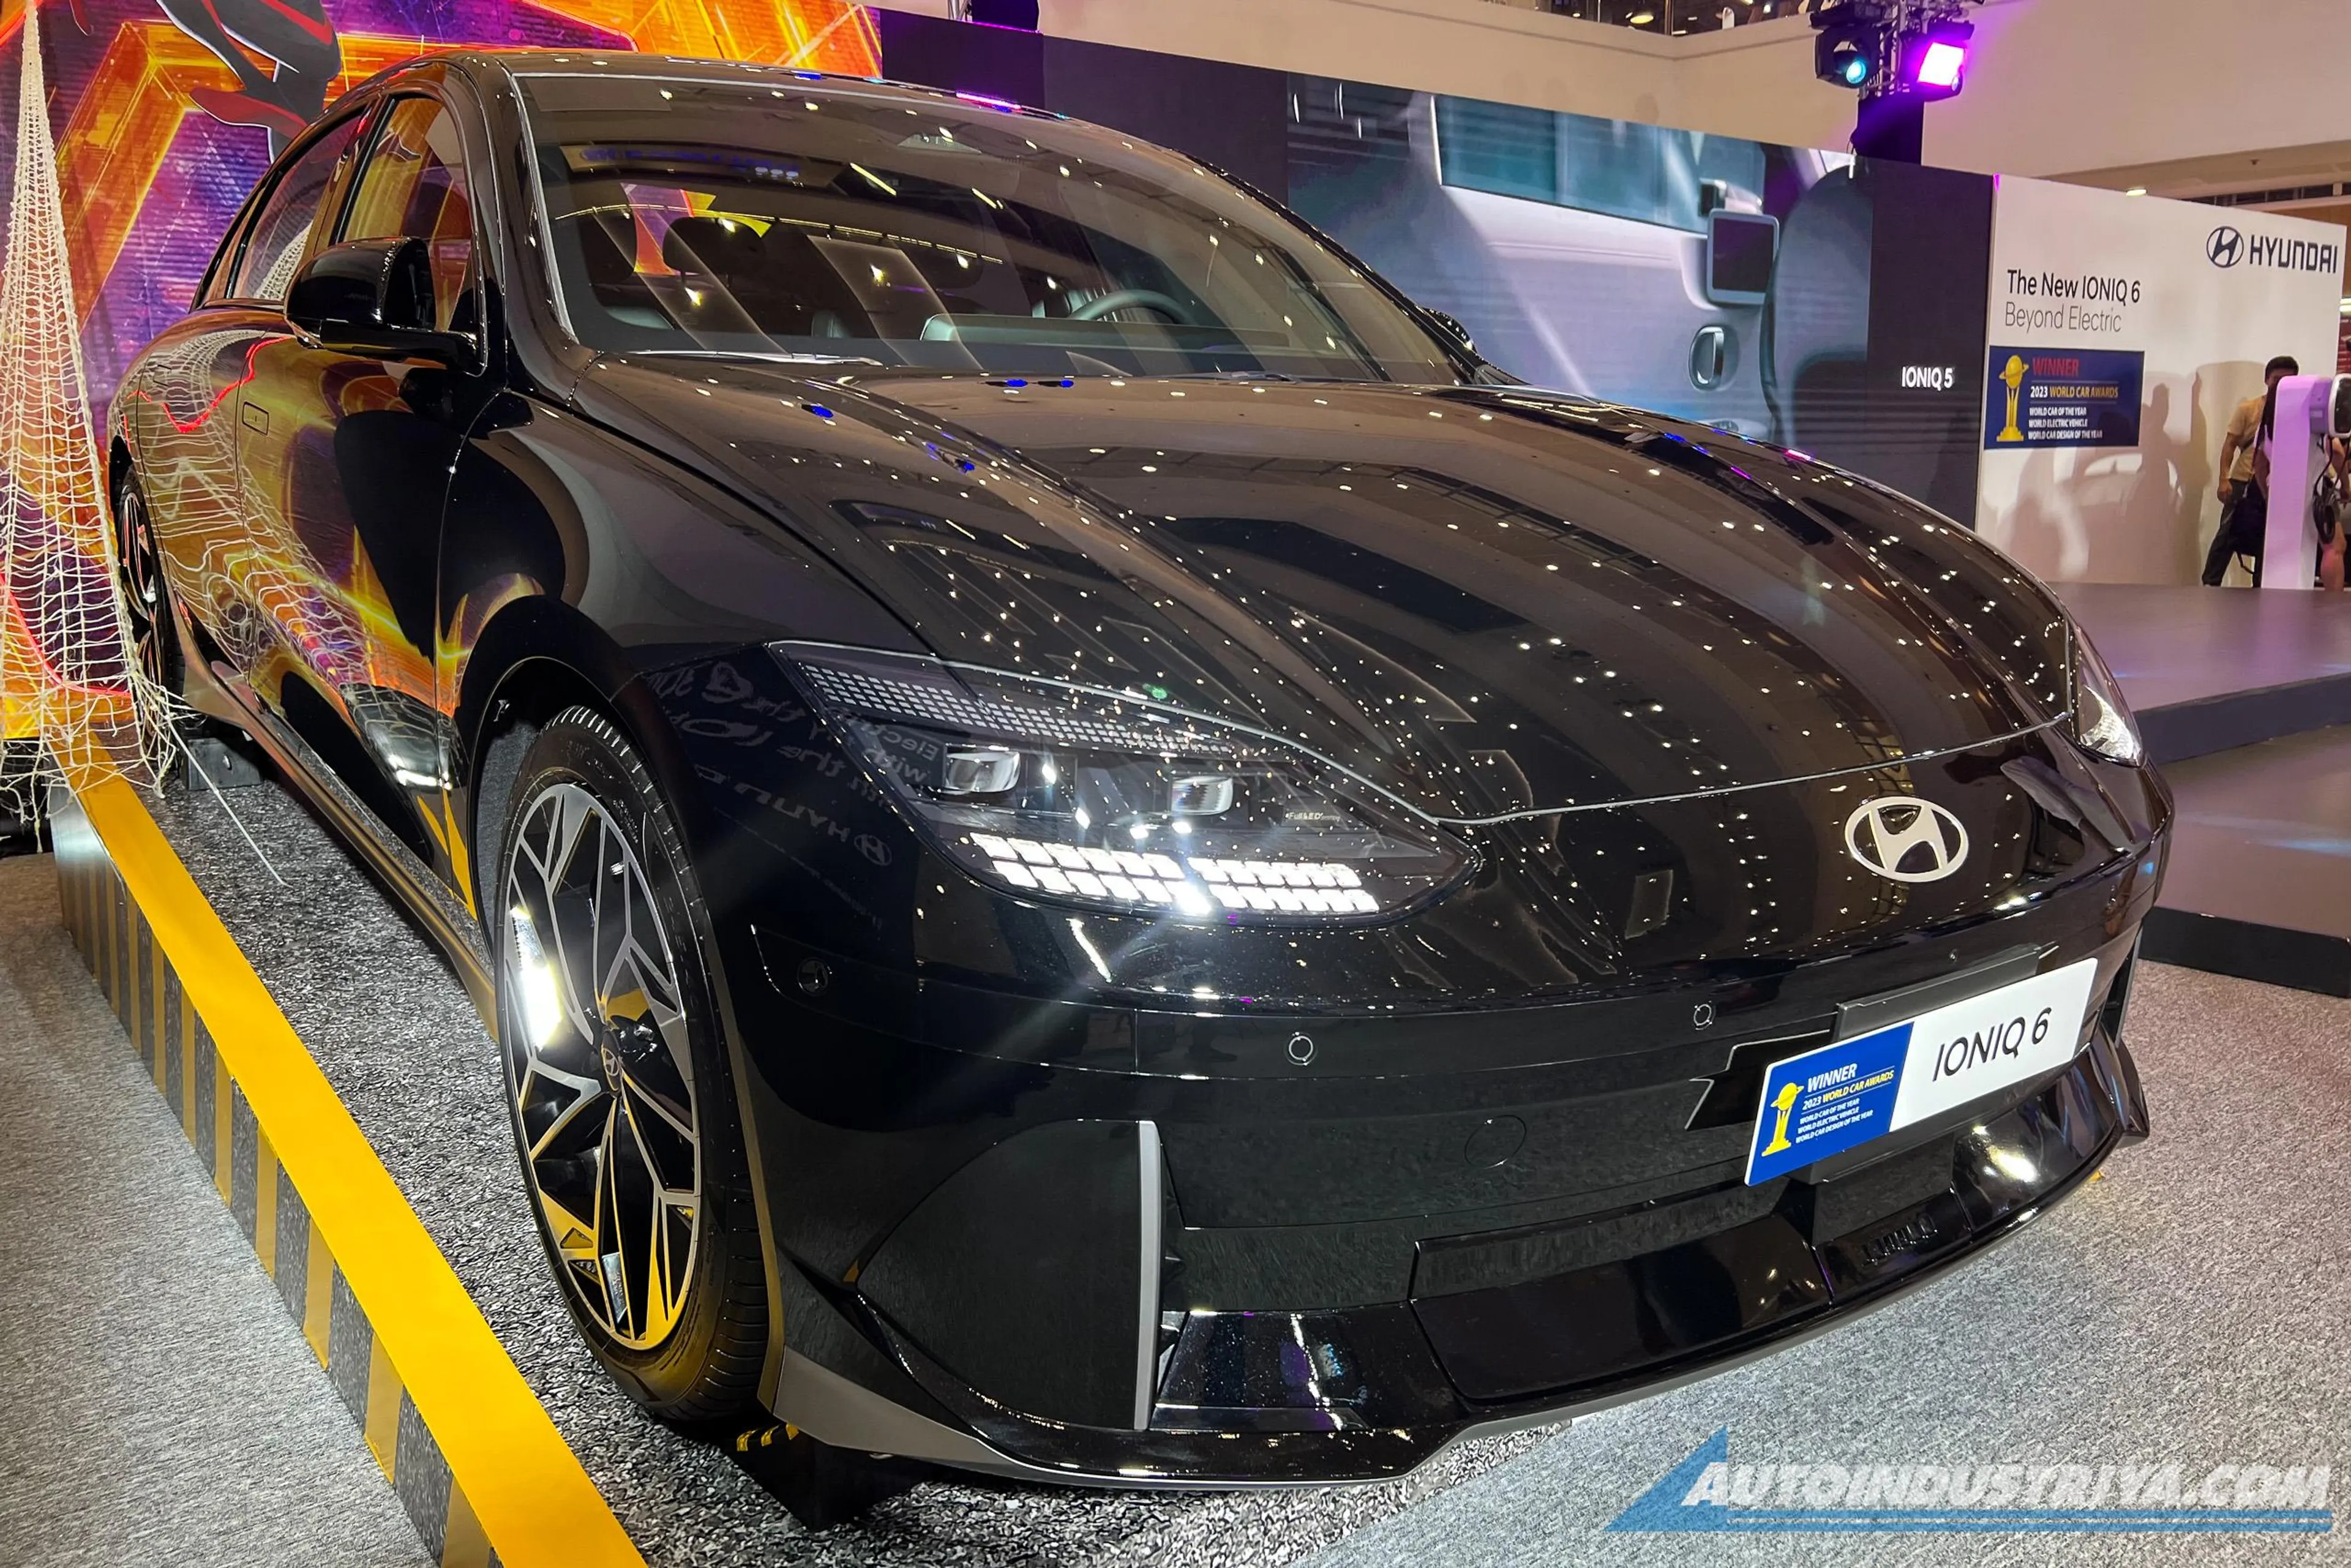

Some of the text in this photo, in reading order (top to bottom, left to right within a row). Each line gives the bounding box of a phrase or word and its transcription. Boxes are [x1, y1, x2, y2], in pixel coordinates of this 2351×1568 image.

[2249, 234, 2338, 274] HYUNDAI
[2007, 269, 2140, 306] The New IONIQ 6
[2005, 301, 2122, 333] Beyond Electric
[1902, 366, 1953, 391] IONIQ 5
[2033, 357, 2079, 377] WINNER
[2030, 386, 2118, 398] 2023 WORLD CAR AWARDS
[2028, 419, 2088, 428] WORLD ELECTRIC VEHICLE
[2029, 407, 2087, 416] WORLD CAR OF THE YEAR
[2028, 430, 2103, 440] WORLD CAR DESIGN OF THE YEAR
[1932, 1007, 2052, 1082] IONIQ 6
[1802, 1070, 1894, 1111] 2023 WORLD CAR AWARDS
[1807, 1063, 1858, 1093] WINNER
[1798, 1106, 1859, 1134] WORLD ELECTRIC VEHICLE
[1800, 1113, 1818, 1125] WORLD
[1819, 1108, 1829, 1118] CAR
[1837, 1103, 1847, 1111] THE
[1847, 1098, 1860, 1108] YEAR
[1795, 1109, 1873, 1144] WORLD CAR DESIGN OF THE YEAR
